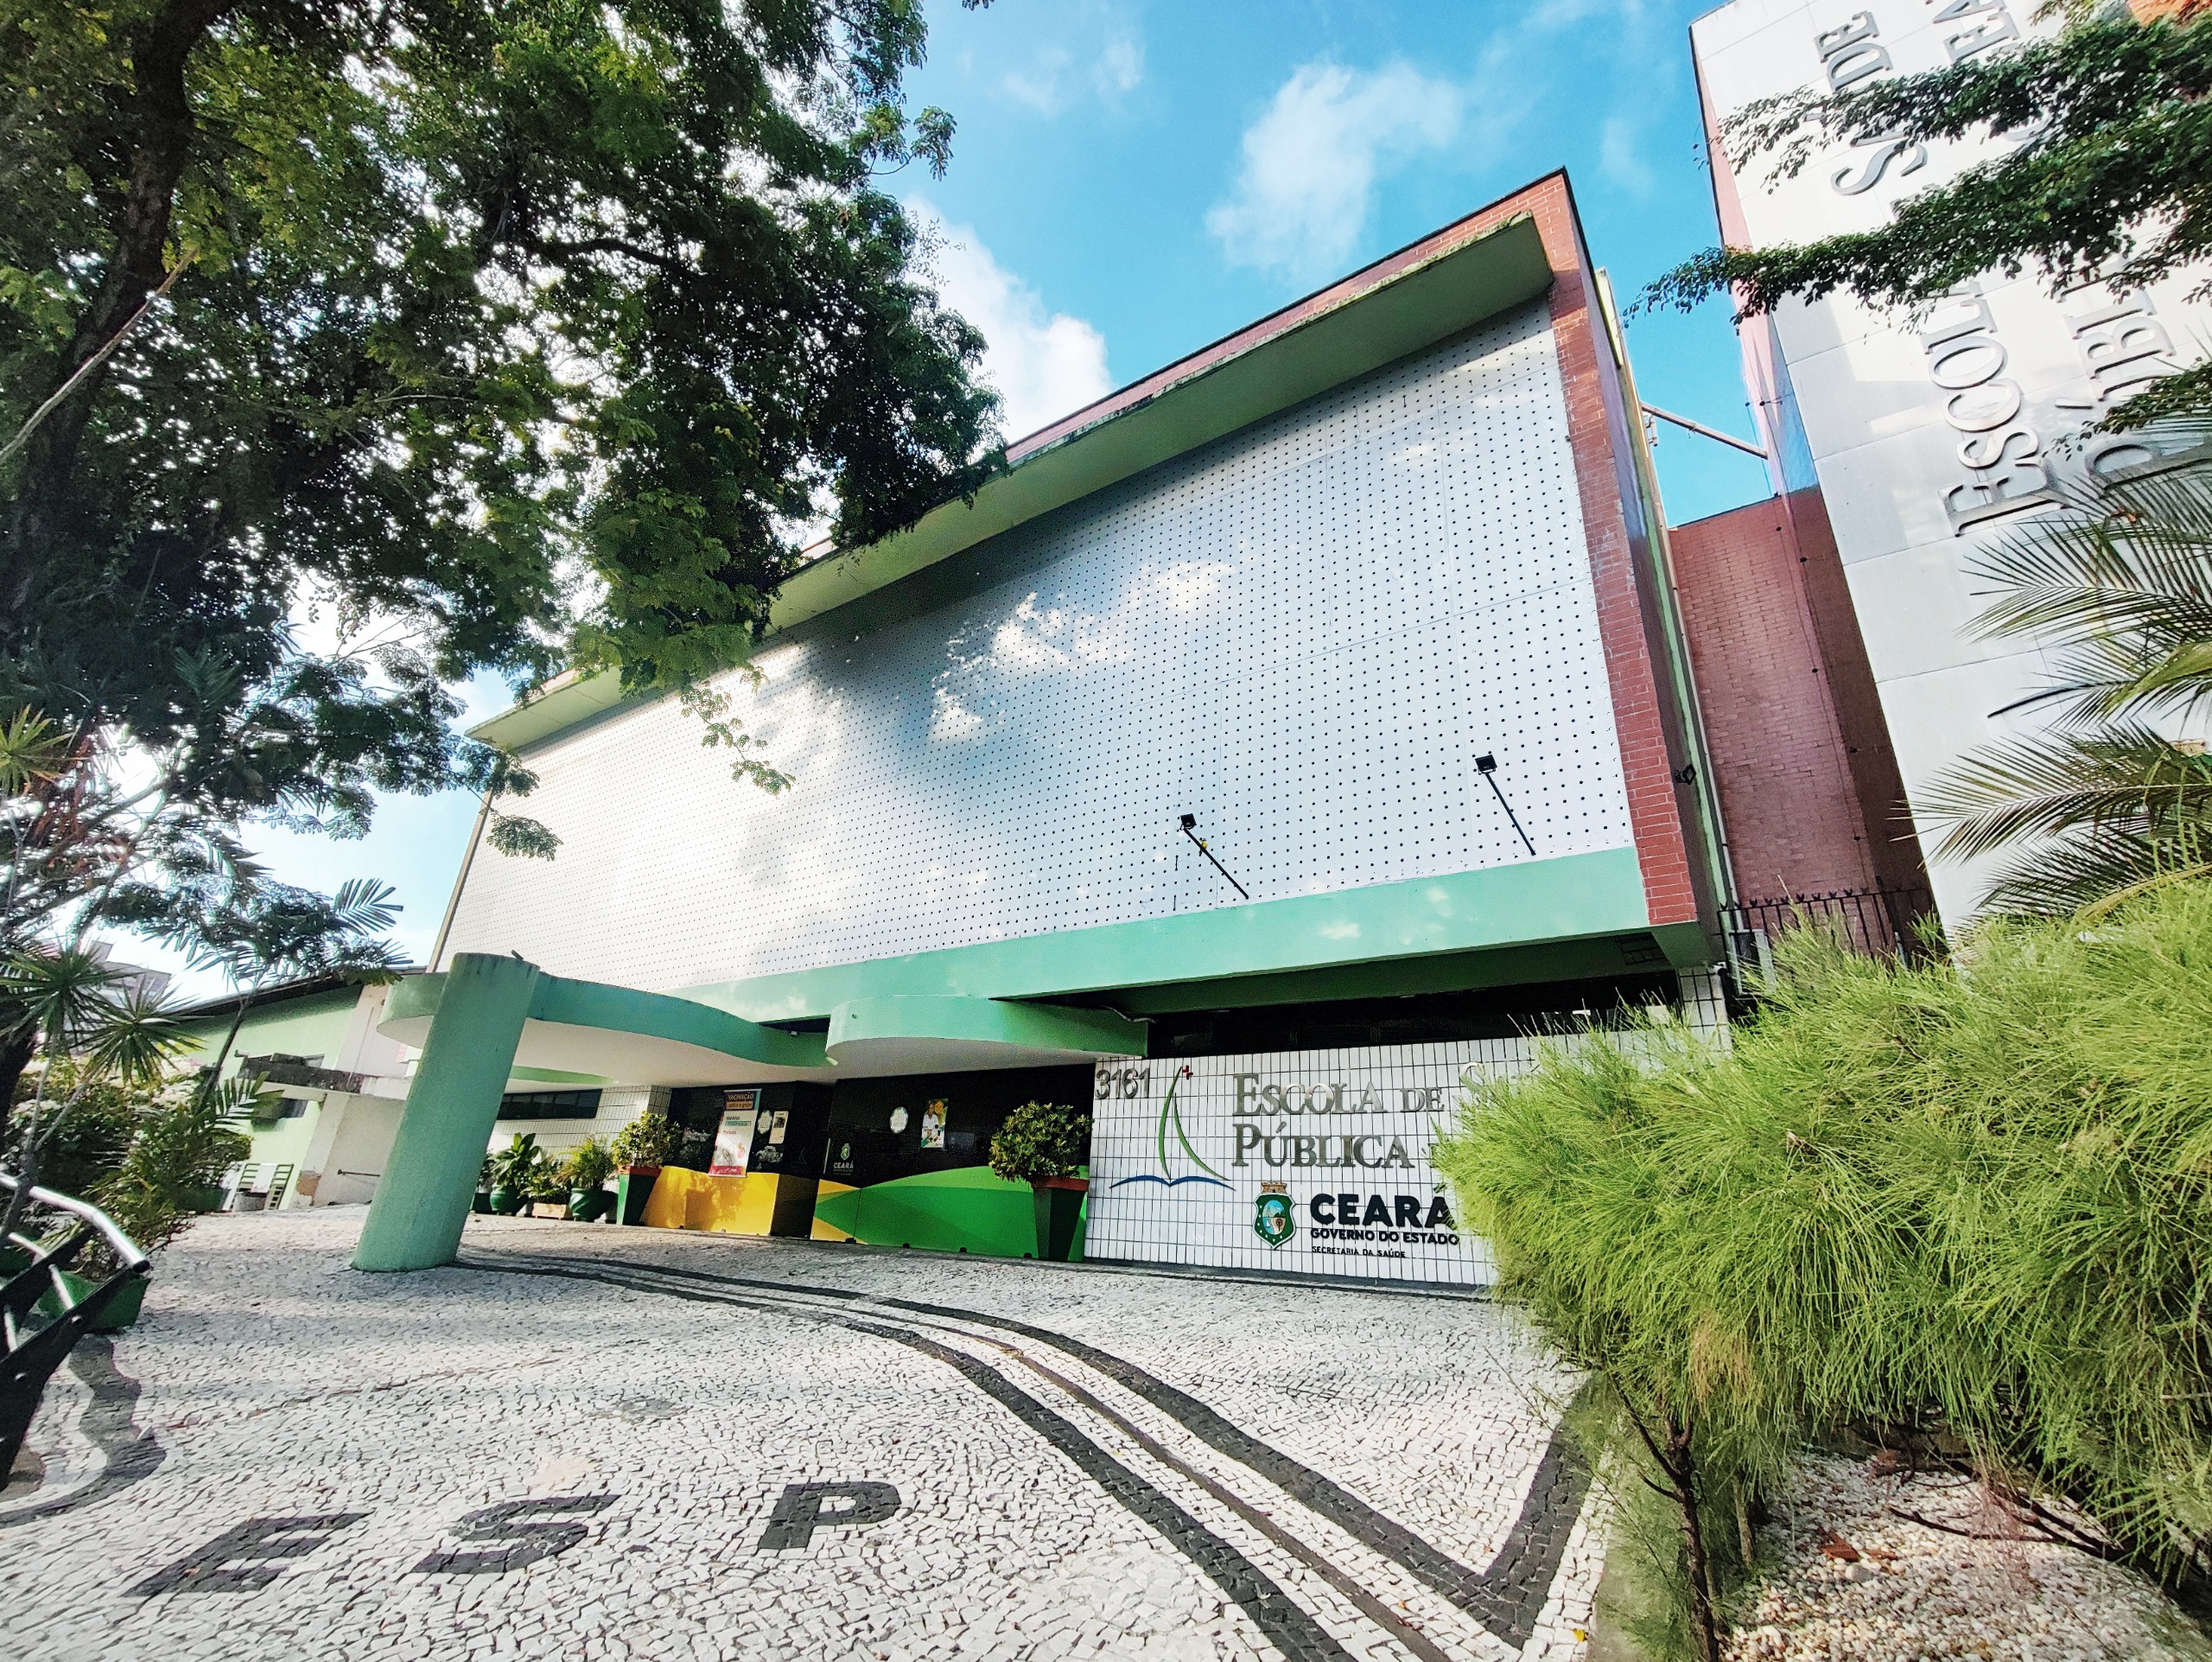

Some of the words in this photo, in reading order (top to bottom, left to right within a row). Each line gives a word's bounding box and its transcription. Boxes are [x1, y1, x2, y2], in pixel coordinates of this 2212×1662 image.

[1094, 1067, 1150, 1099] 3161
[1232, 1073, 1388, 1116] ESCOLA
[1399, 1086, 1445, 1112] DE
[1231, 1121, 1415, 1168] PÚBLICA
[833, 1161, 854, 1169] CEARÁ
[1310, 1227, 1375, 1242] GOVERNO
[1378, 1231, 1400, 1243] DO
[1402, 1232, 1459, 1245] ESTADO
[1312, 1245, 1359, 1256] SECRETARIA
[1377, 1247, 1406, 1258] SAÚDE
